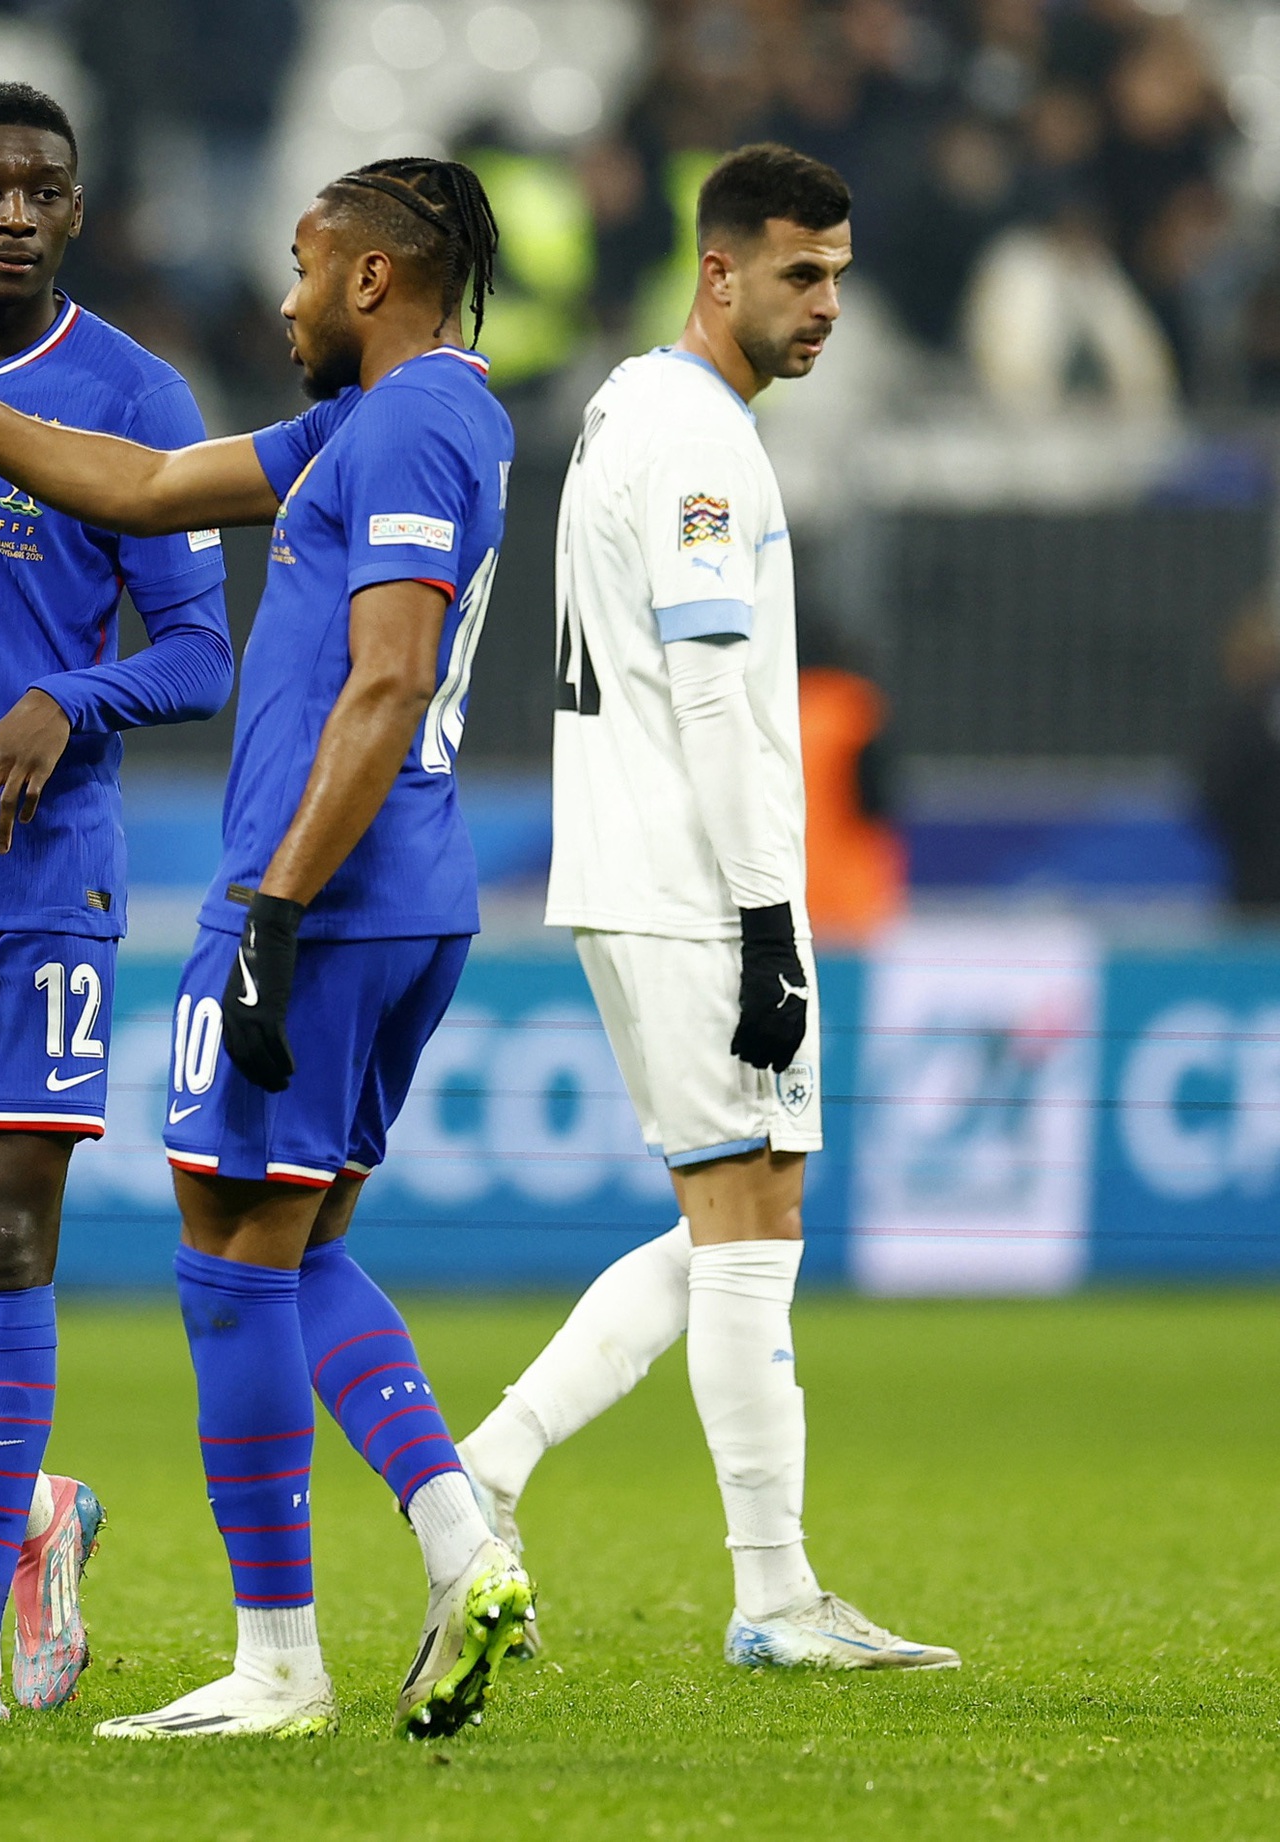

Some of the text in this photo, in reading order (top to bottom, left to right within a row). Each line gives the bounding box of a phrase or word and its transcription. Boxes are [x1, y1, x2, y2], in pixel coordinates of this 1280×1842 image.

[372, 524, 451, 541] FOUNDATION
[34, 962, 105, 1059] 12
[173, 993, 224, 1096] 10
